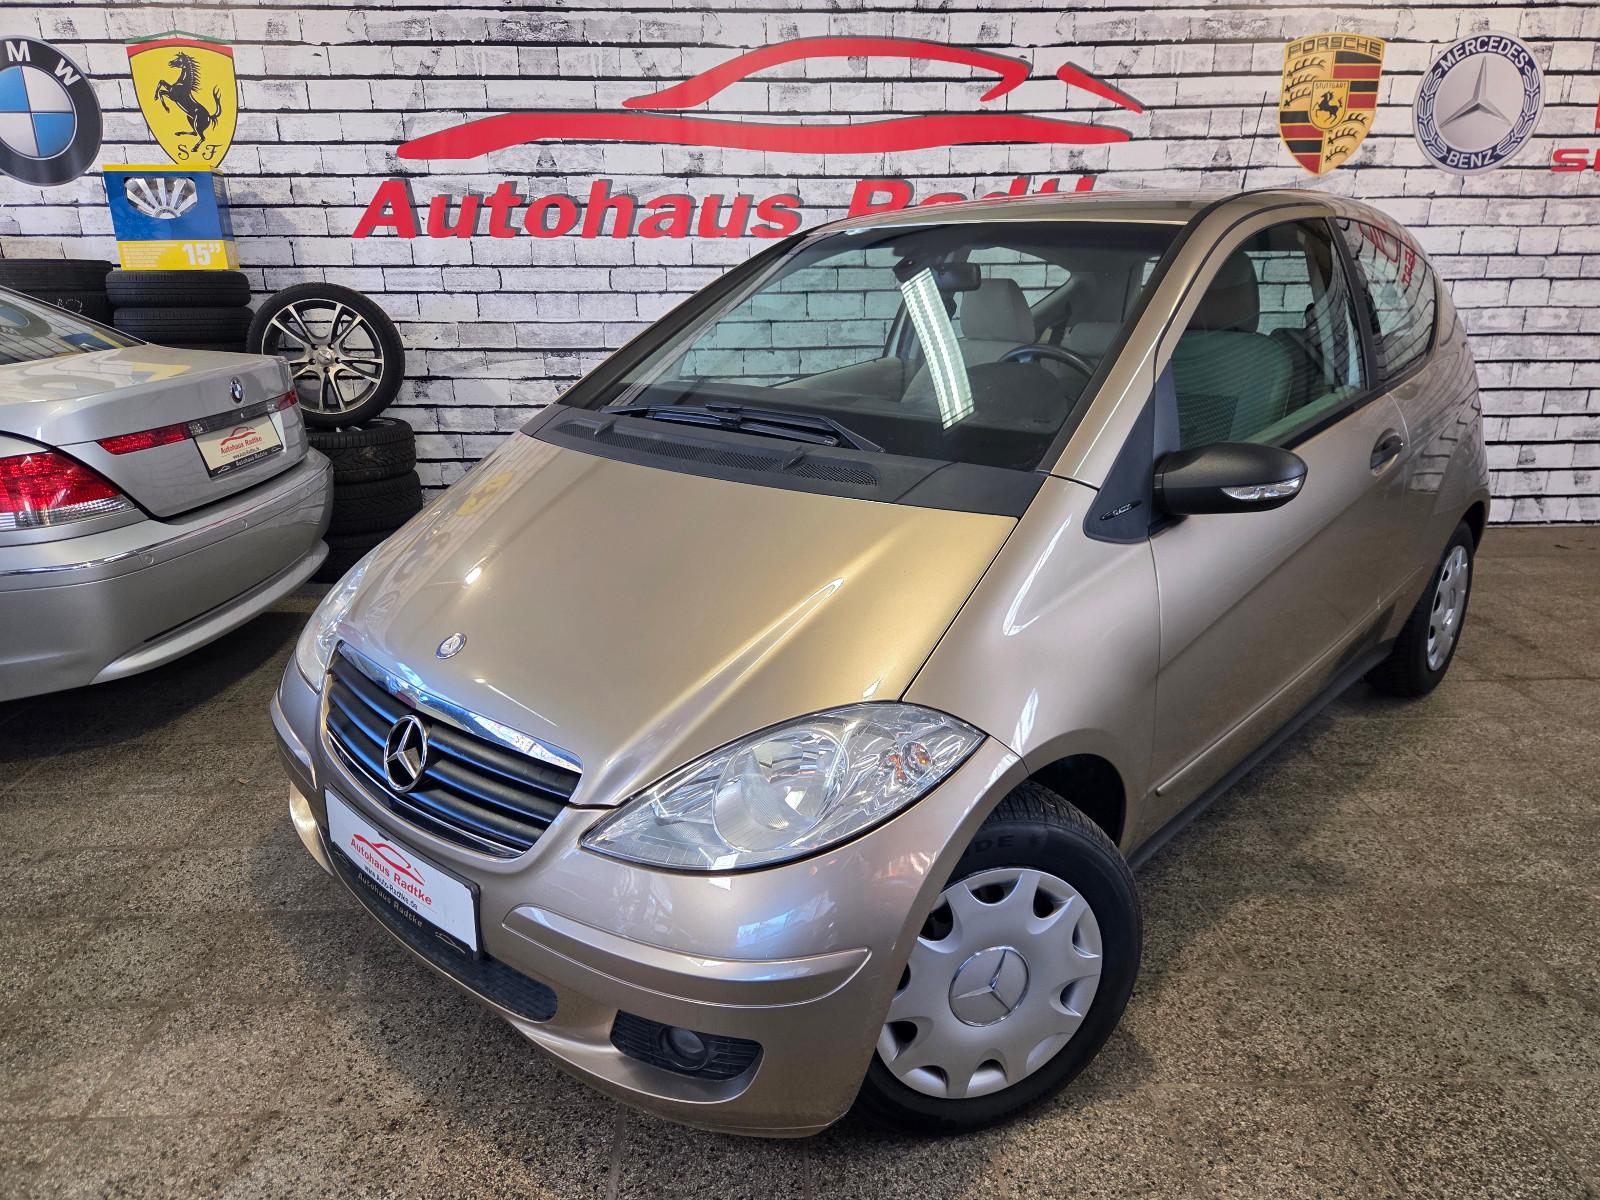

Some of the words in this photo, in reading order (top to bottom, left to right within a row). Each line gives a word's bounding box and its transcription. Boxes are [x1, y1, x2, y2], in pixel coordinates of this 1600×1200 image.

[1288, 37, 1381, 59] PORSCHE
[1440, 37, 1527, 70] MERCEDES
[1447, 150, 1496, 169] BENZ
[1551, 148, 1600, 171] S
[352, 178, 804, 239] Autohaus
[221, 443, 244, 454] Autohaus
[245, 436, 262, 446] Radtke
[351, 838, 390, 877] Autohaus
[393, 872, 432, 905] Radtke
[358, 873, 391, 904] Autohaus
[393, 902, 423, 927] Radtke
